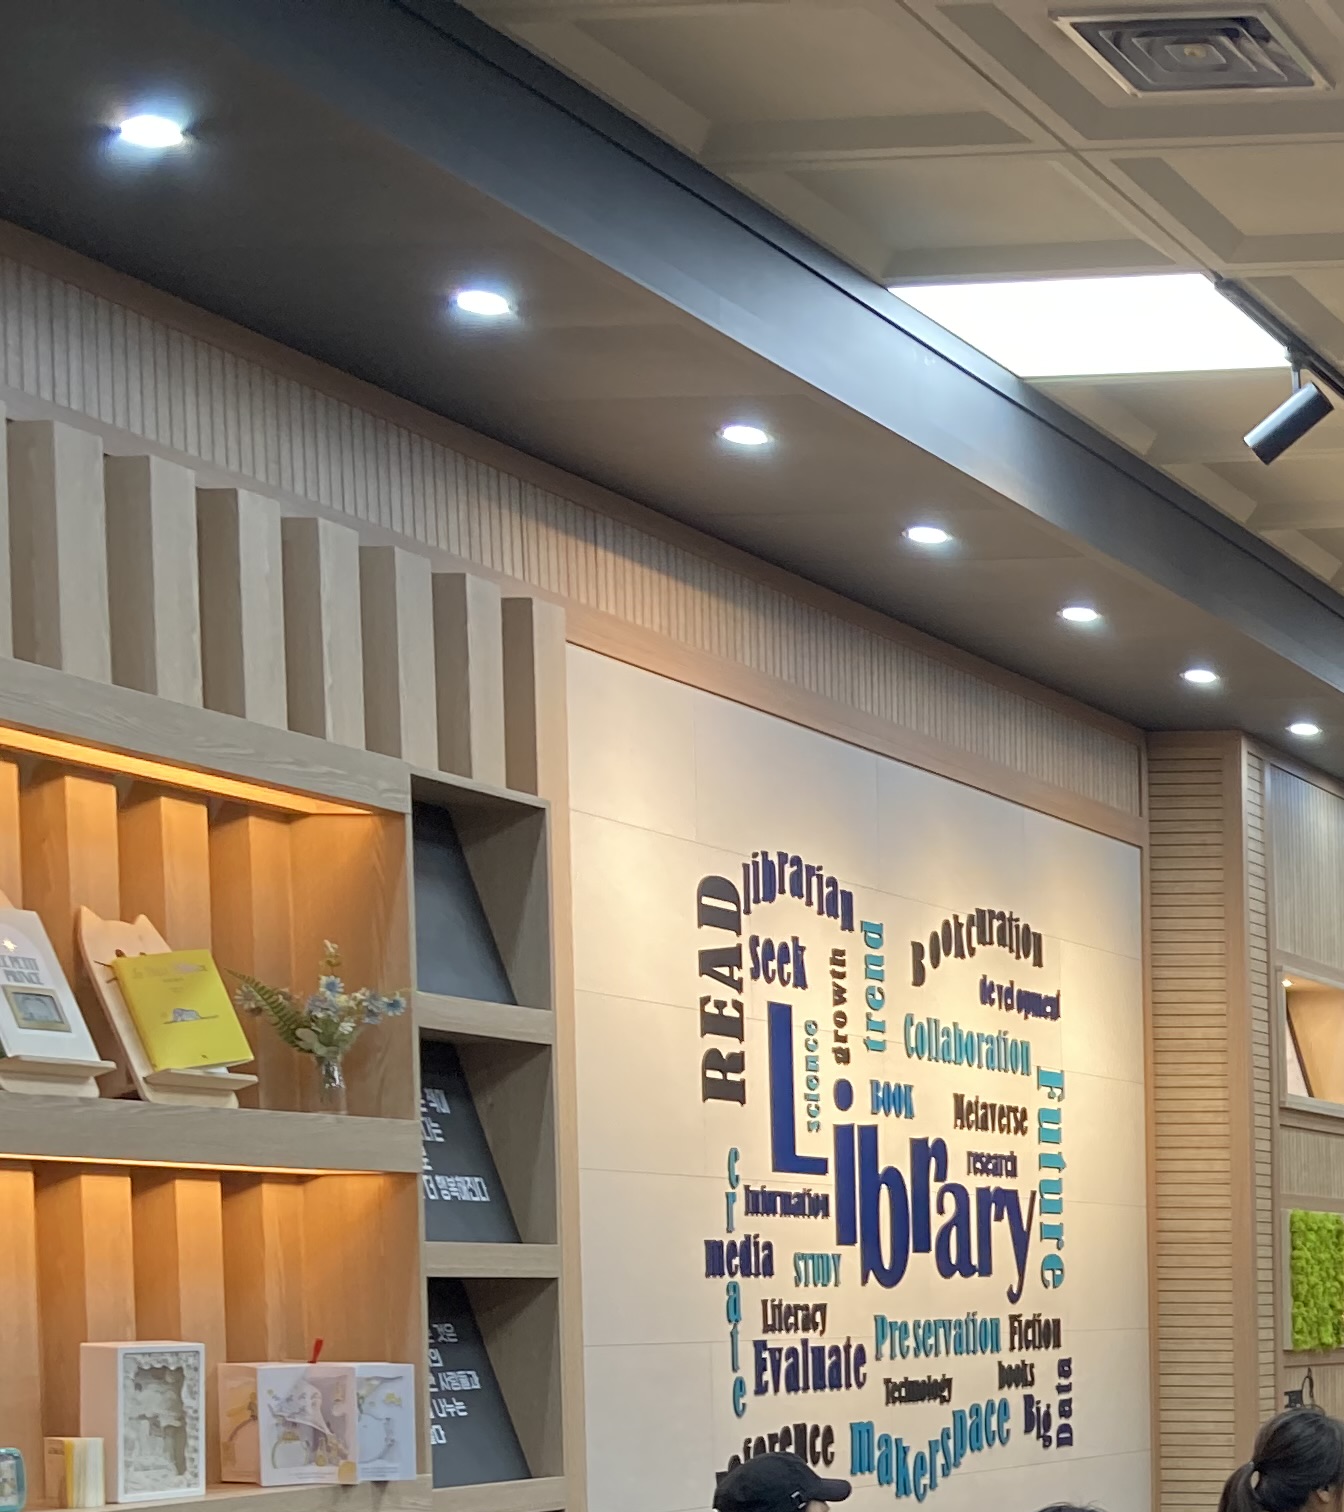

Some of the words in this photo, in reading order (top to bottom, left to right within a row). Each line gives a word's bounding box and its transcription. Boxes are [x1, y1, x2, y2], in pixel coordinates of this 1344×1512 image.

[742, 851, 854, 933] librarian
[749, 934, 808, 991] seek
[911, 907, 1044, 987] Bookcuration
[697, 875, 746, 1107] READ
[829, 948, 851, 1066] growth
[860, 920, 887, 1052] trend
[904, 1013, 1032, 1076] Collaboration
[804, 1019, 821, 1133] science
[869, 1079, 914, 1120] BOOK
[953, 1092, 1029, 1136] Metaverse
[767, 1000, 1037, 1305] Library
[966, 1150, 1018, 1178] research
[1036, 1066, 1067, 1289] Future
[743, 1184, 831, 1219] Information
[704, 1233, 775, 1278] media
[793, 1251, 842, 1287] STUDY
[761, 1298, 828, 1337] Literacy
[873, 1311, 1002, 1361] Preservation
[1008, 1313, 1062, 1352] Fiction
[753, 1336, 868, 1395] Evaluate
[883, 1374, 954, 1406] Technology
[998, 1360, 1036, 1391] books
[1023, 1394, 1053, 1449] Big
[1055, 1357, 1074, 1448] Data
[849, 1397, 1011, 1502] makerspace
